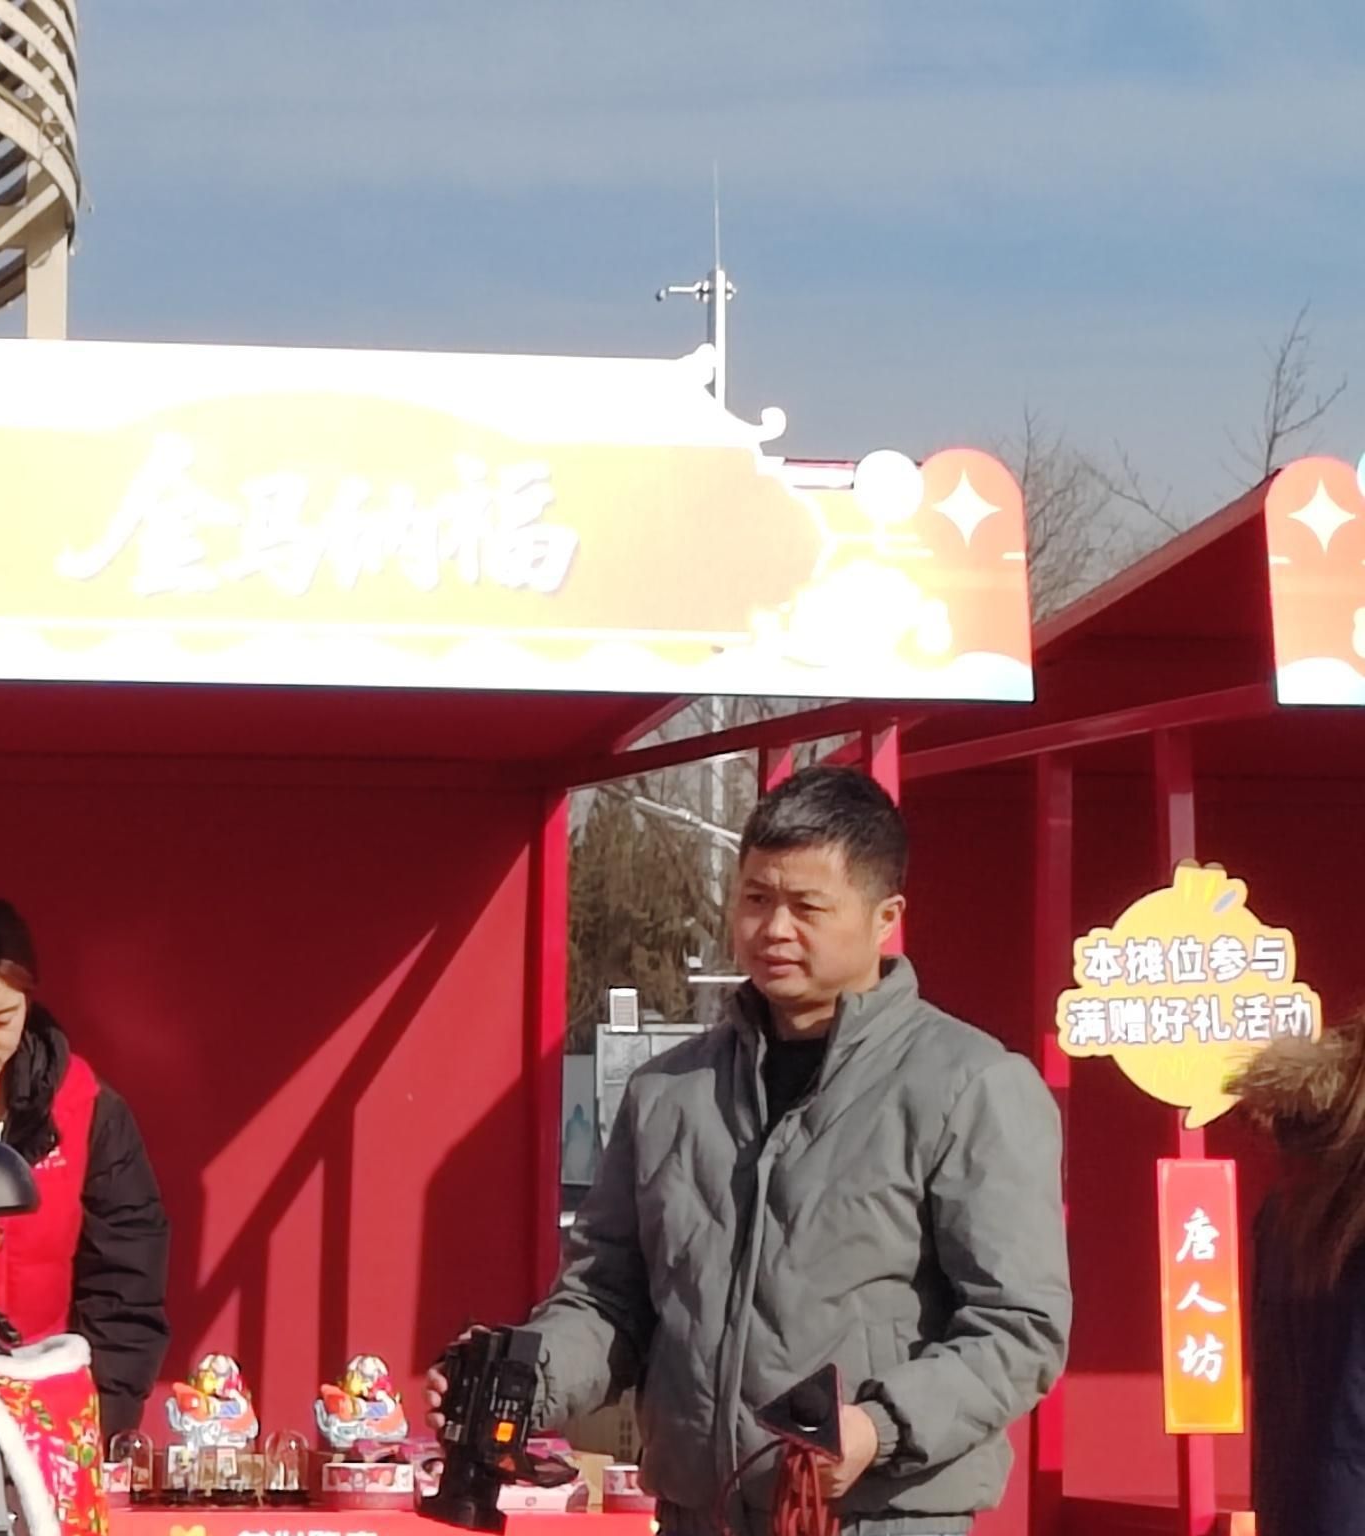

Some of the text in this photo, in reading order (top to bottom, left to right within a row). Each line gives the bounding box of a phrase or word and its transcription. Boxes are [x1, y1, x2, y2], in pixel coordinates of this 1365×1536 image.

[54, 431, 580, 599] 金马纳福
[1083, 935, 1286, 985] 本摊位参与
[1067, 991, 1313, 1046] 满赠好礼活动
[1176, 1206, 1227, 1383] 唐人坊
